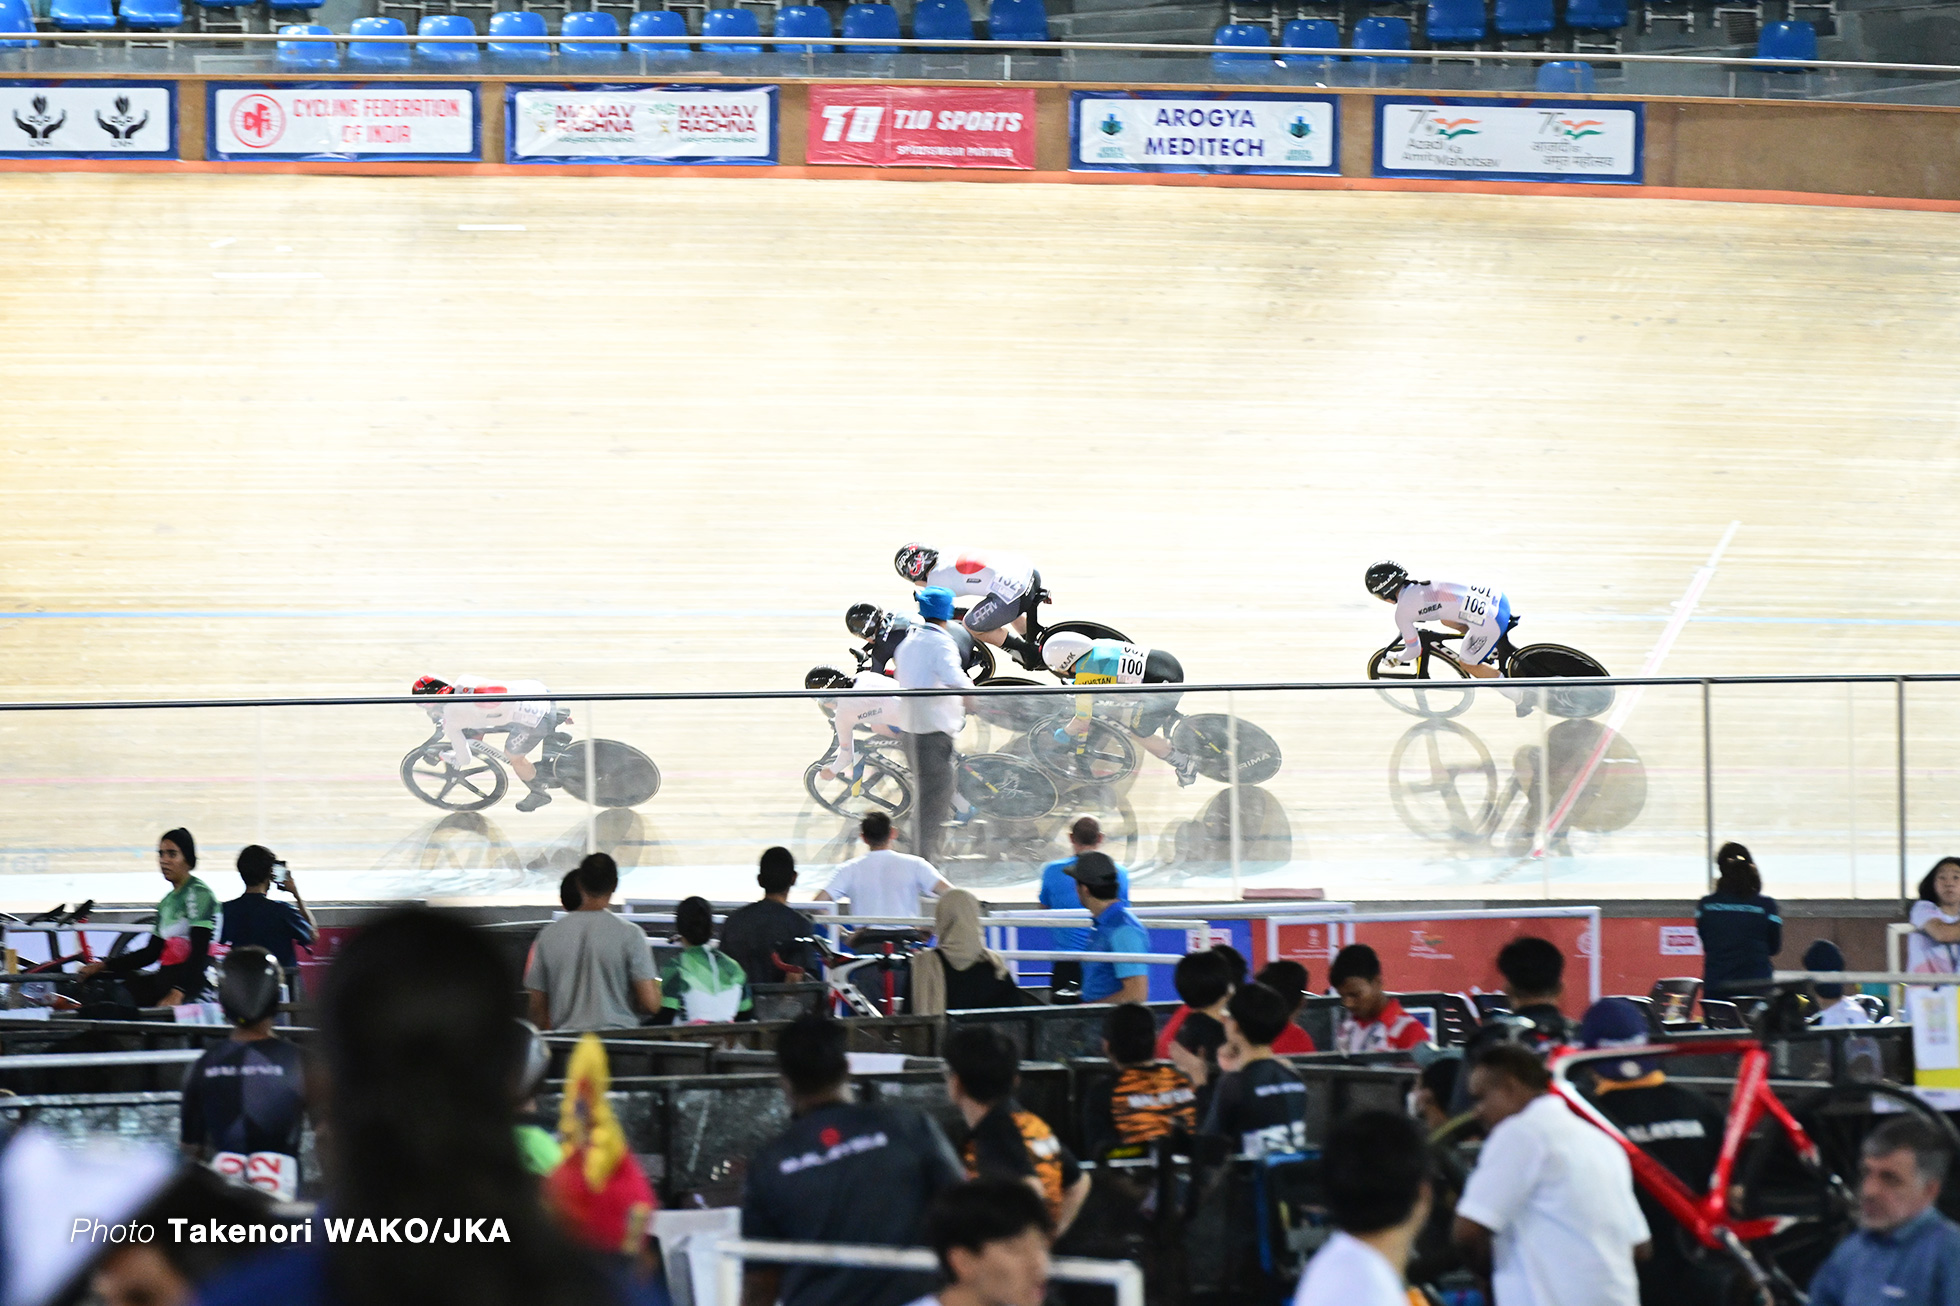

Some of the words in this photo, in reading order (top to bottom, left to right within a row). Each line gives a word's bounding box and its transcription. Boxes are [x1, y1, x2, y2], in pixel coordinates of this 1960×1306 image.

[293, 99, 359, 117] CYCLING
[363, 99, 460, 117] FEDERATION
[555, 105, 636, 119] MANAV
[678, 105, 758, 119] MANAV
[936, 110, 1024, 132] SPORTS
[1155, 108, 1256, 128] AROGYA
[341, 125, 363, 143] OF
[555, 120, 636, 133] RACHNA
[678, 120, 758, 133] RACHNA
[896, 145, 965, 157] SPORTSWEAR
[966, 147, 1014, 158] PARTNER
[1145, 137, 1265, 157] MEDITECH
[1407, 138, 1443, 151] Azadi
[1402, 152, 1434, 163] Amrit
[1434, 156, 1501, 168] Mahotsav
[972, 601, 998, 625] JAPAN
[1418, 603, 1443, 616] KOREA
[1464, 595, 1486, 616] 108
[1121, 658, 1143, 676] 100
[857, 707, 883, 720] KOREA
